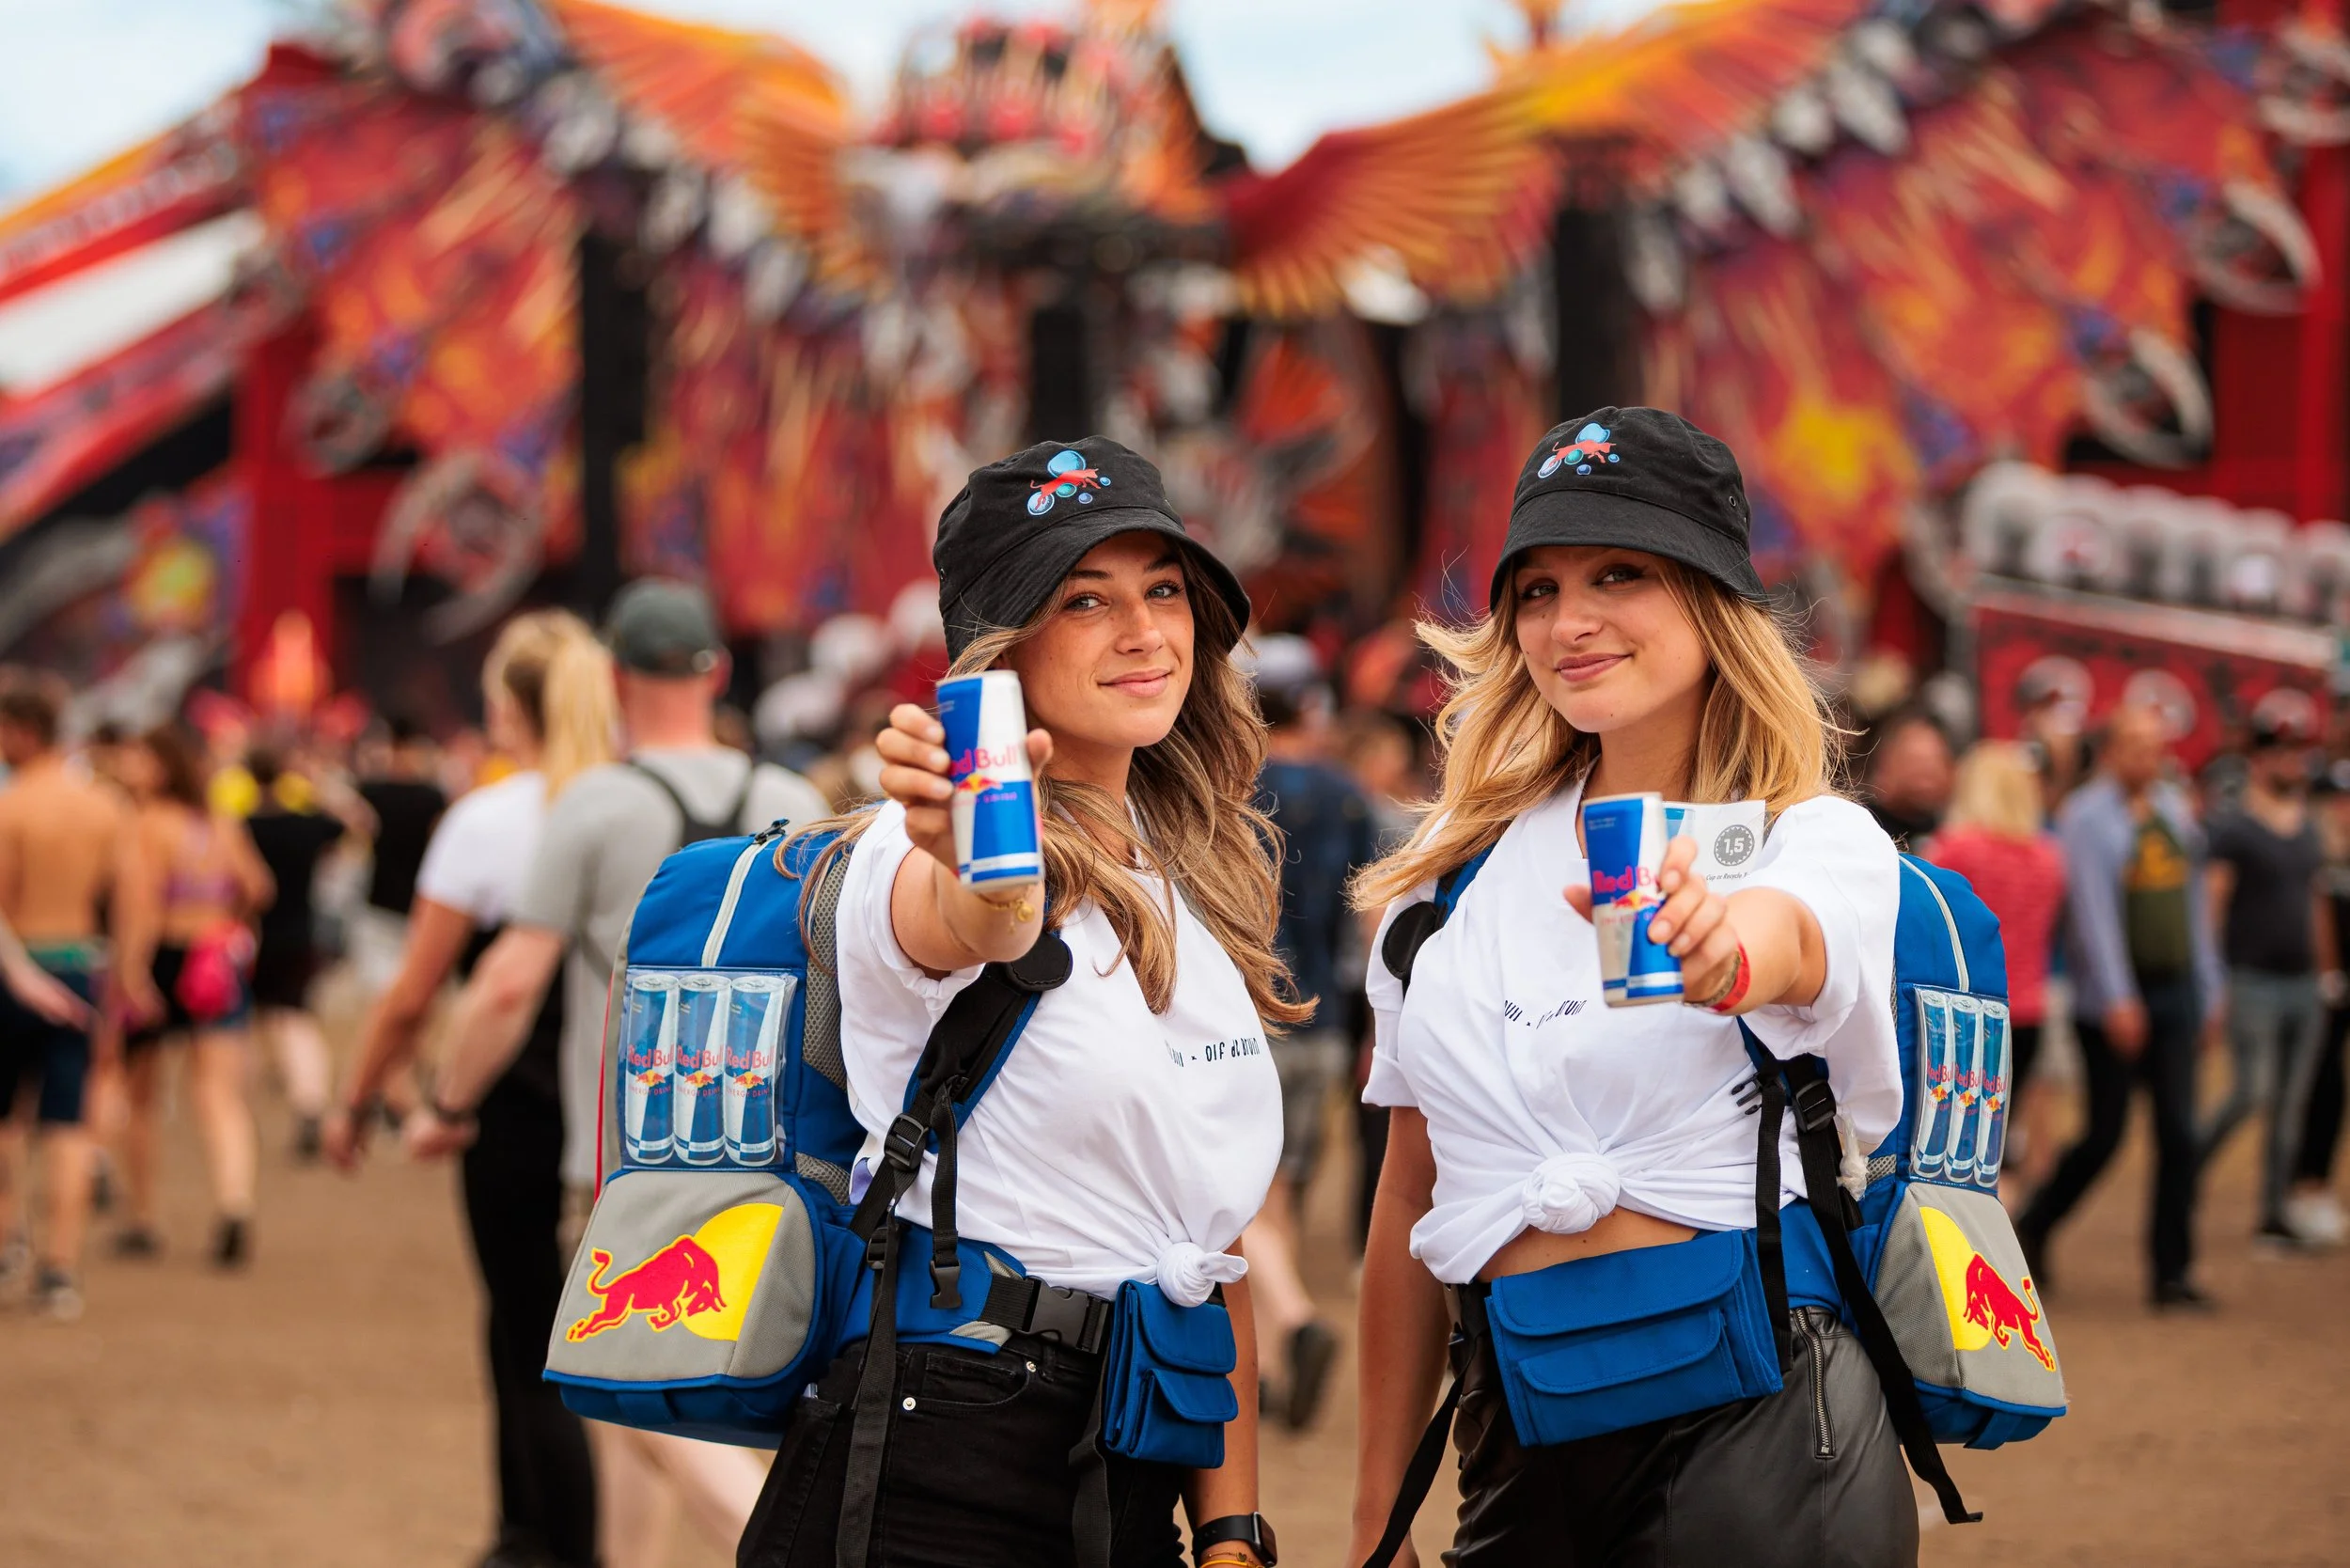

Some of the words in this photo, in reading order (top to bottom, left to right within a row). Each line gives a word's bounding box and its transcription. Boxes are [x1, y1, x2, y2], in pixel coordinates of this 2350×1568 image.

[949, 748, 973, 776] ed
[1724, 838, 1745, 855] 1,5
[1592, 865, 1634, 894] Red
[628, 1044, 651, 1069] Red
[677, 1045, 699, 1069] Red
[727, 1045, 750, 1070] Red
